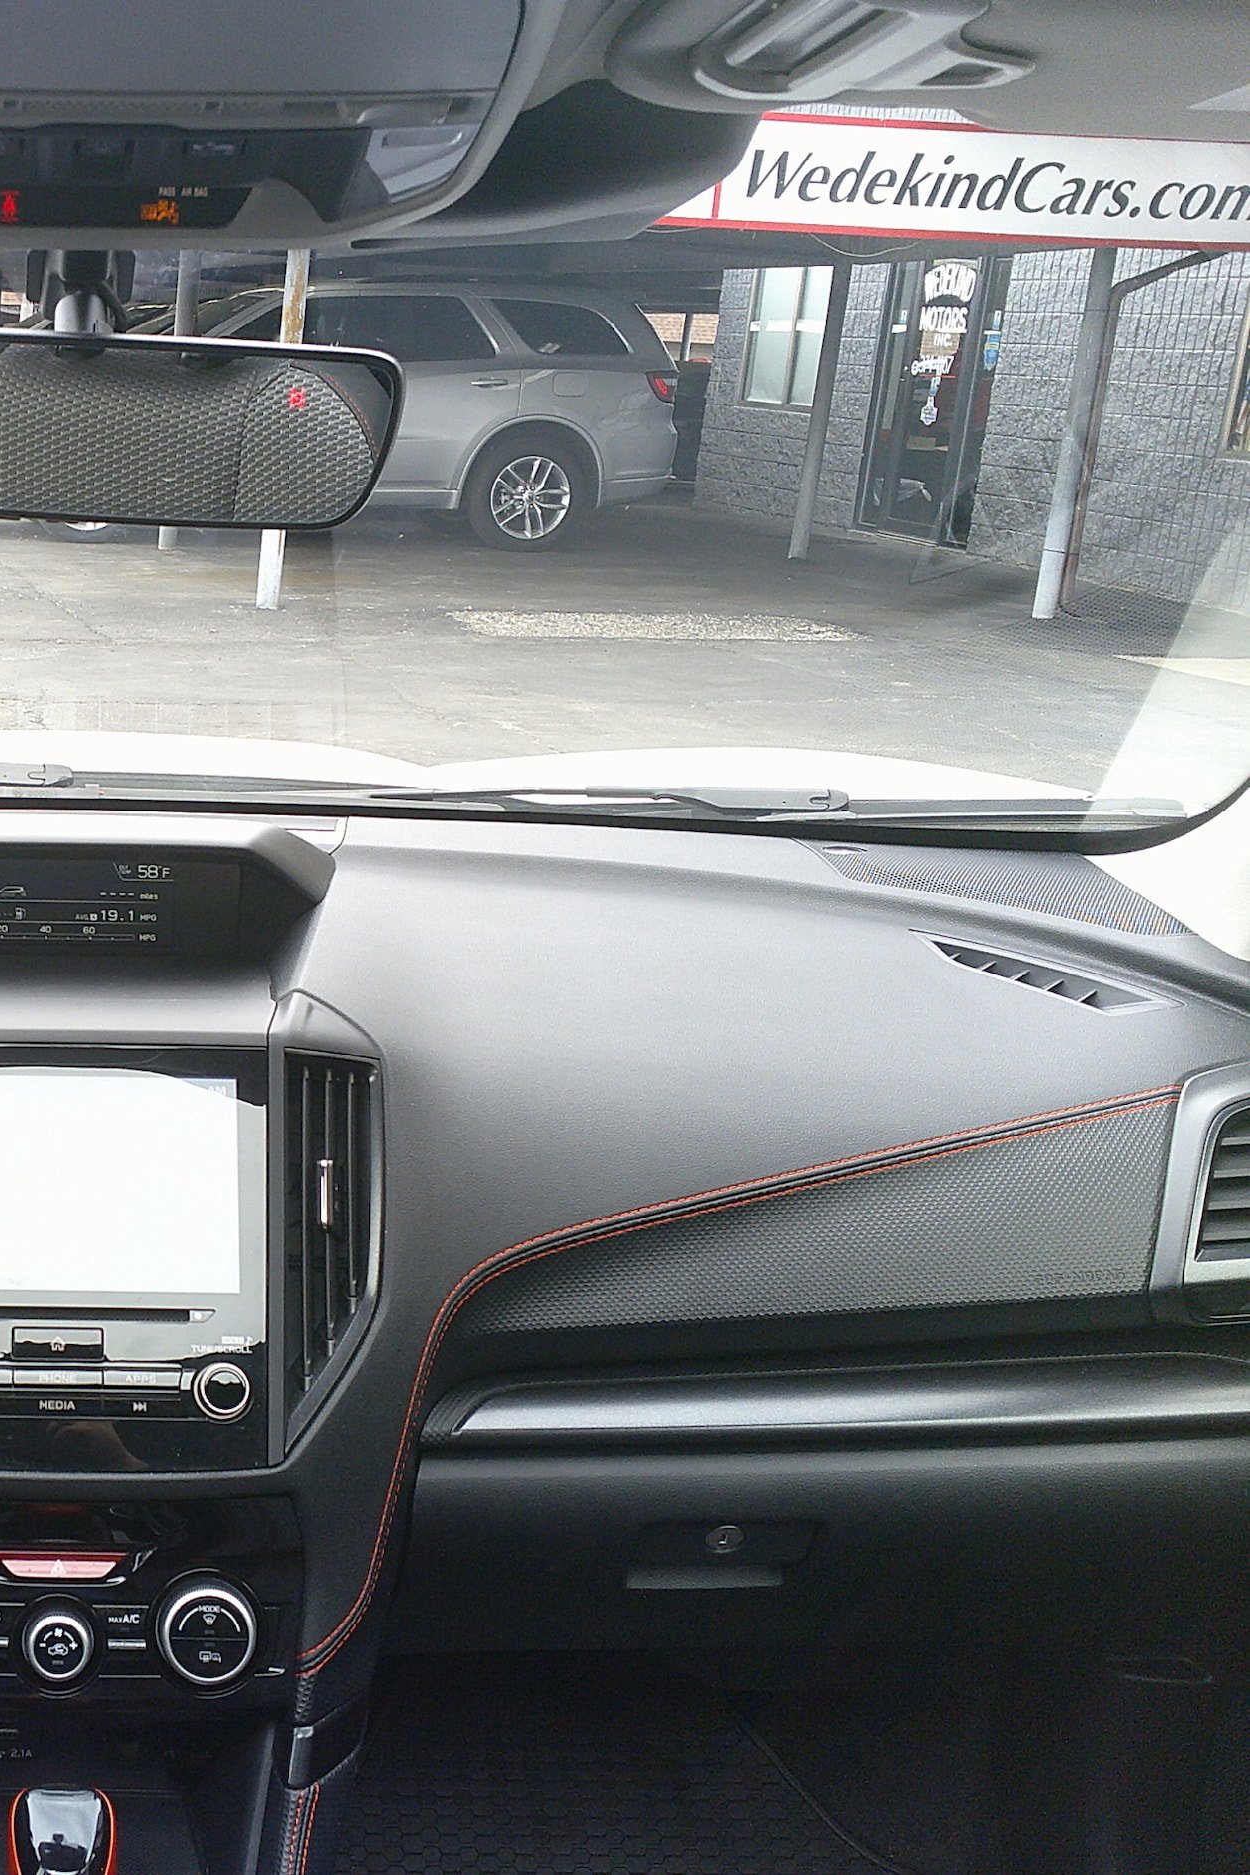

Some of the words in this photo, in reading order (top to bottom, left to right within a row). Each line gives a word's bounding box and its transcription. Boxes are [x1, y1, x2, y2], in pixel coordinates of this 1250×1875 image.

[745, 148, 1250, 220] WedekindCars.com
[925, 264, 977, 304] WEDEKIND
[100, 909, 134, 922] 19.1
[139, 914, 158, 922] MPG
[39, 925, 52, 934] 40
[82, 926, 96, 935] 60
[138, 934, 157, 942] MPG
[38, 1374, 78, 1384] PHONE
[124, 1374, 157, 1384] APPS
[38, 1400, 76, 1411] MEDIA
[197, 1605, 221, 1614] MODE
